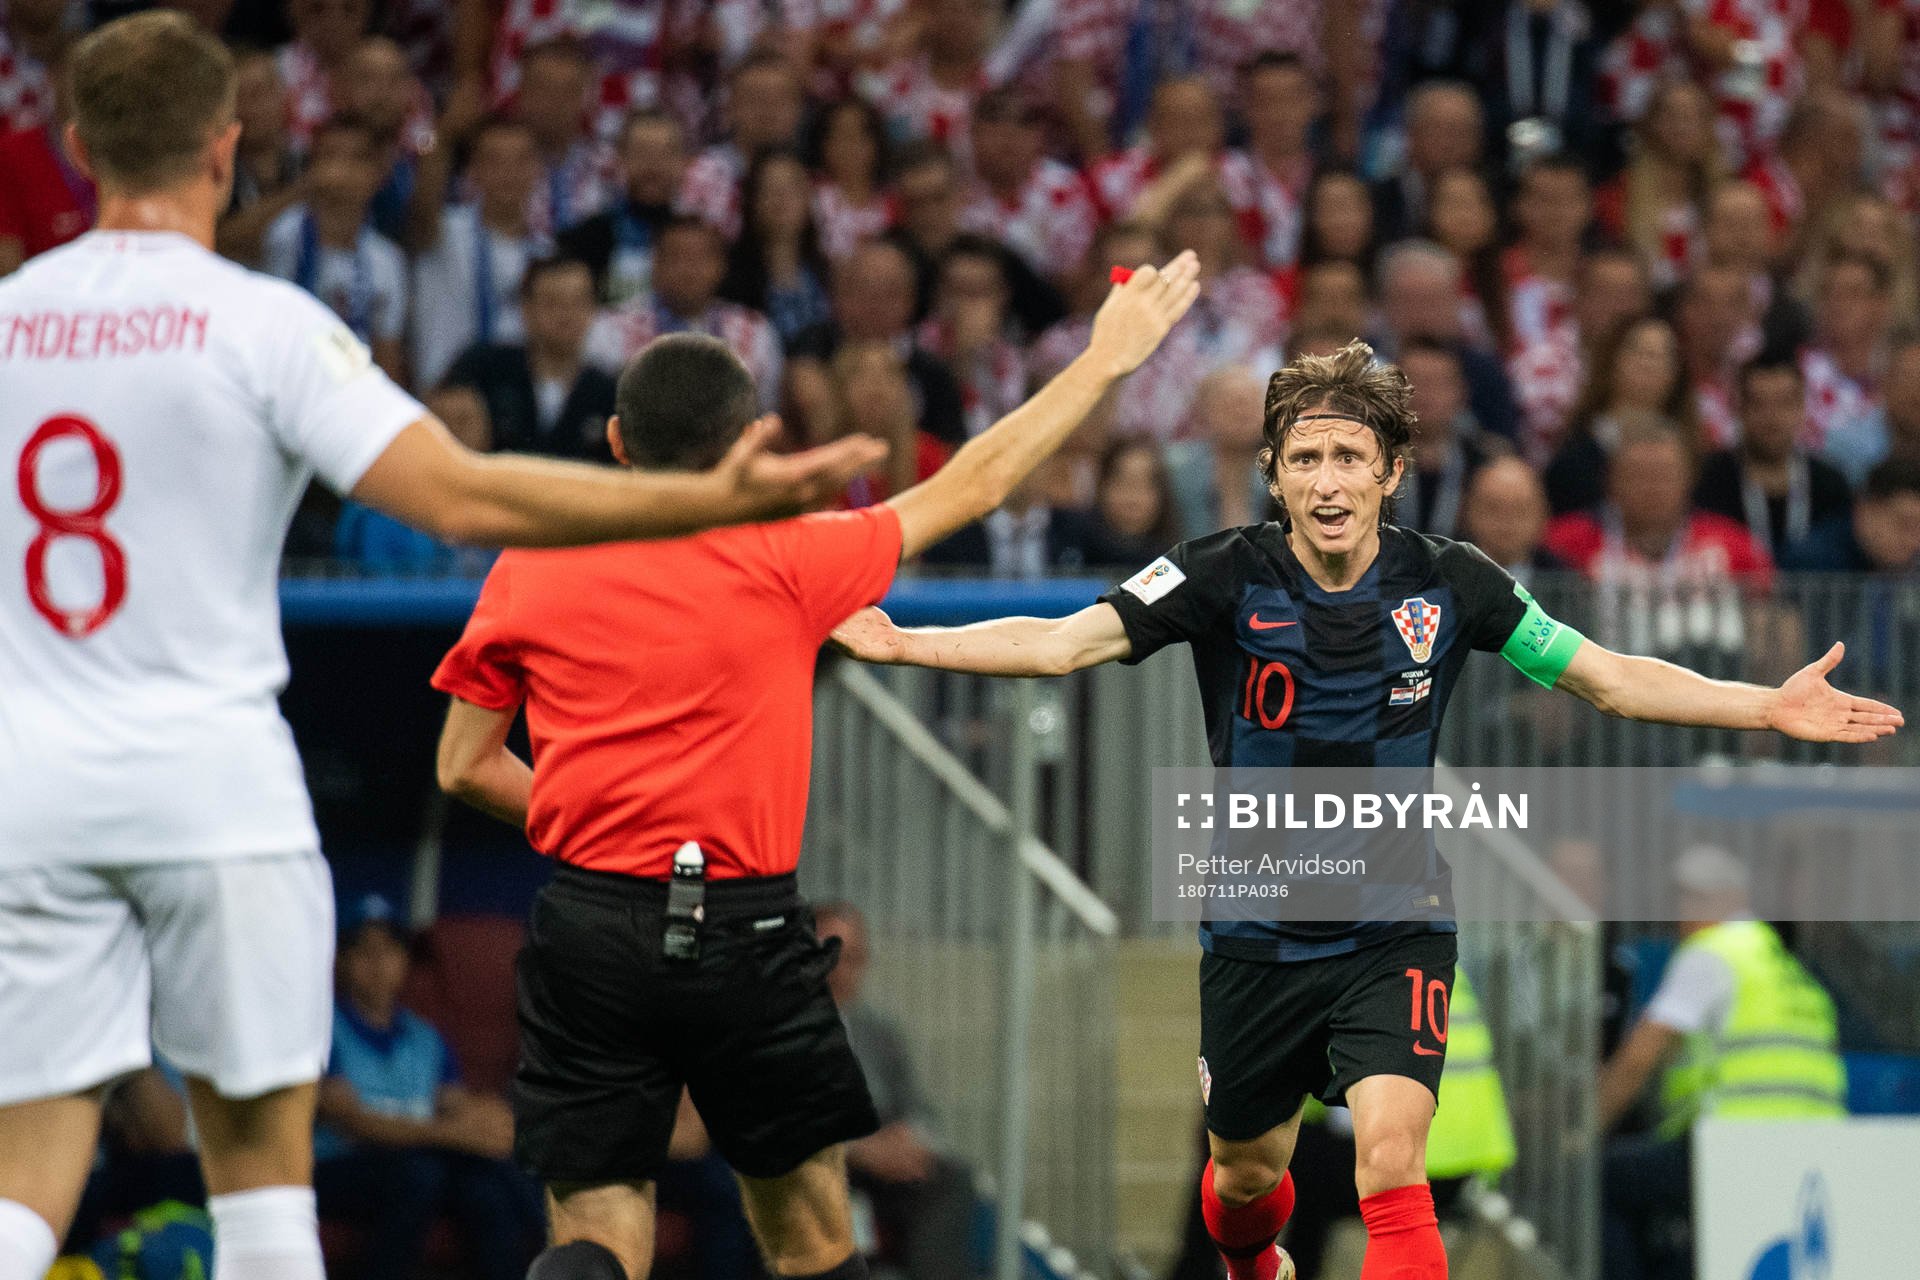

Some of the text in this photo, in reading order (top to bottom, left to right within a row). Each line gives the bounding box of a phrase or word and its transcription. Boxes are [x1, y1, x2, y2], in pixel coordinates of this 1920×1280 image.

[17, 412, 126, 640] 8
[1243, 657, 1295, 729] 10
[1405, 968, 1449, 1044] 10
